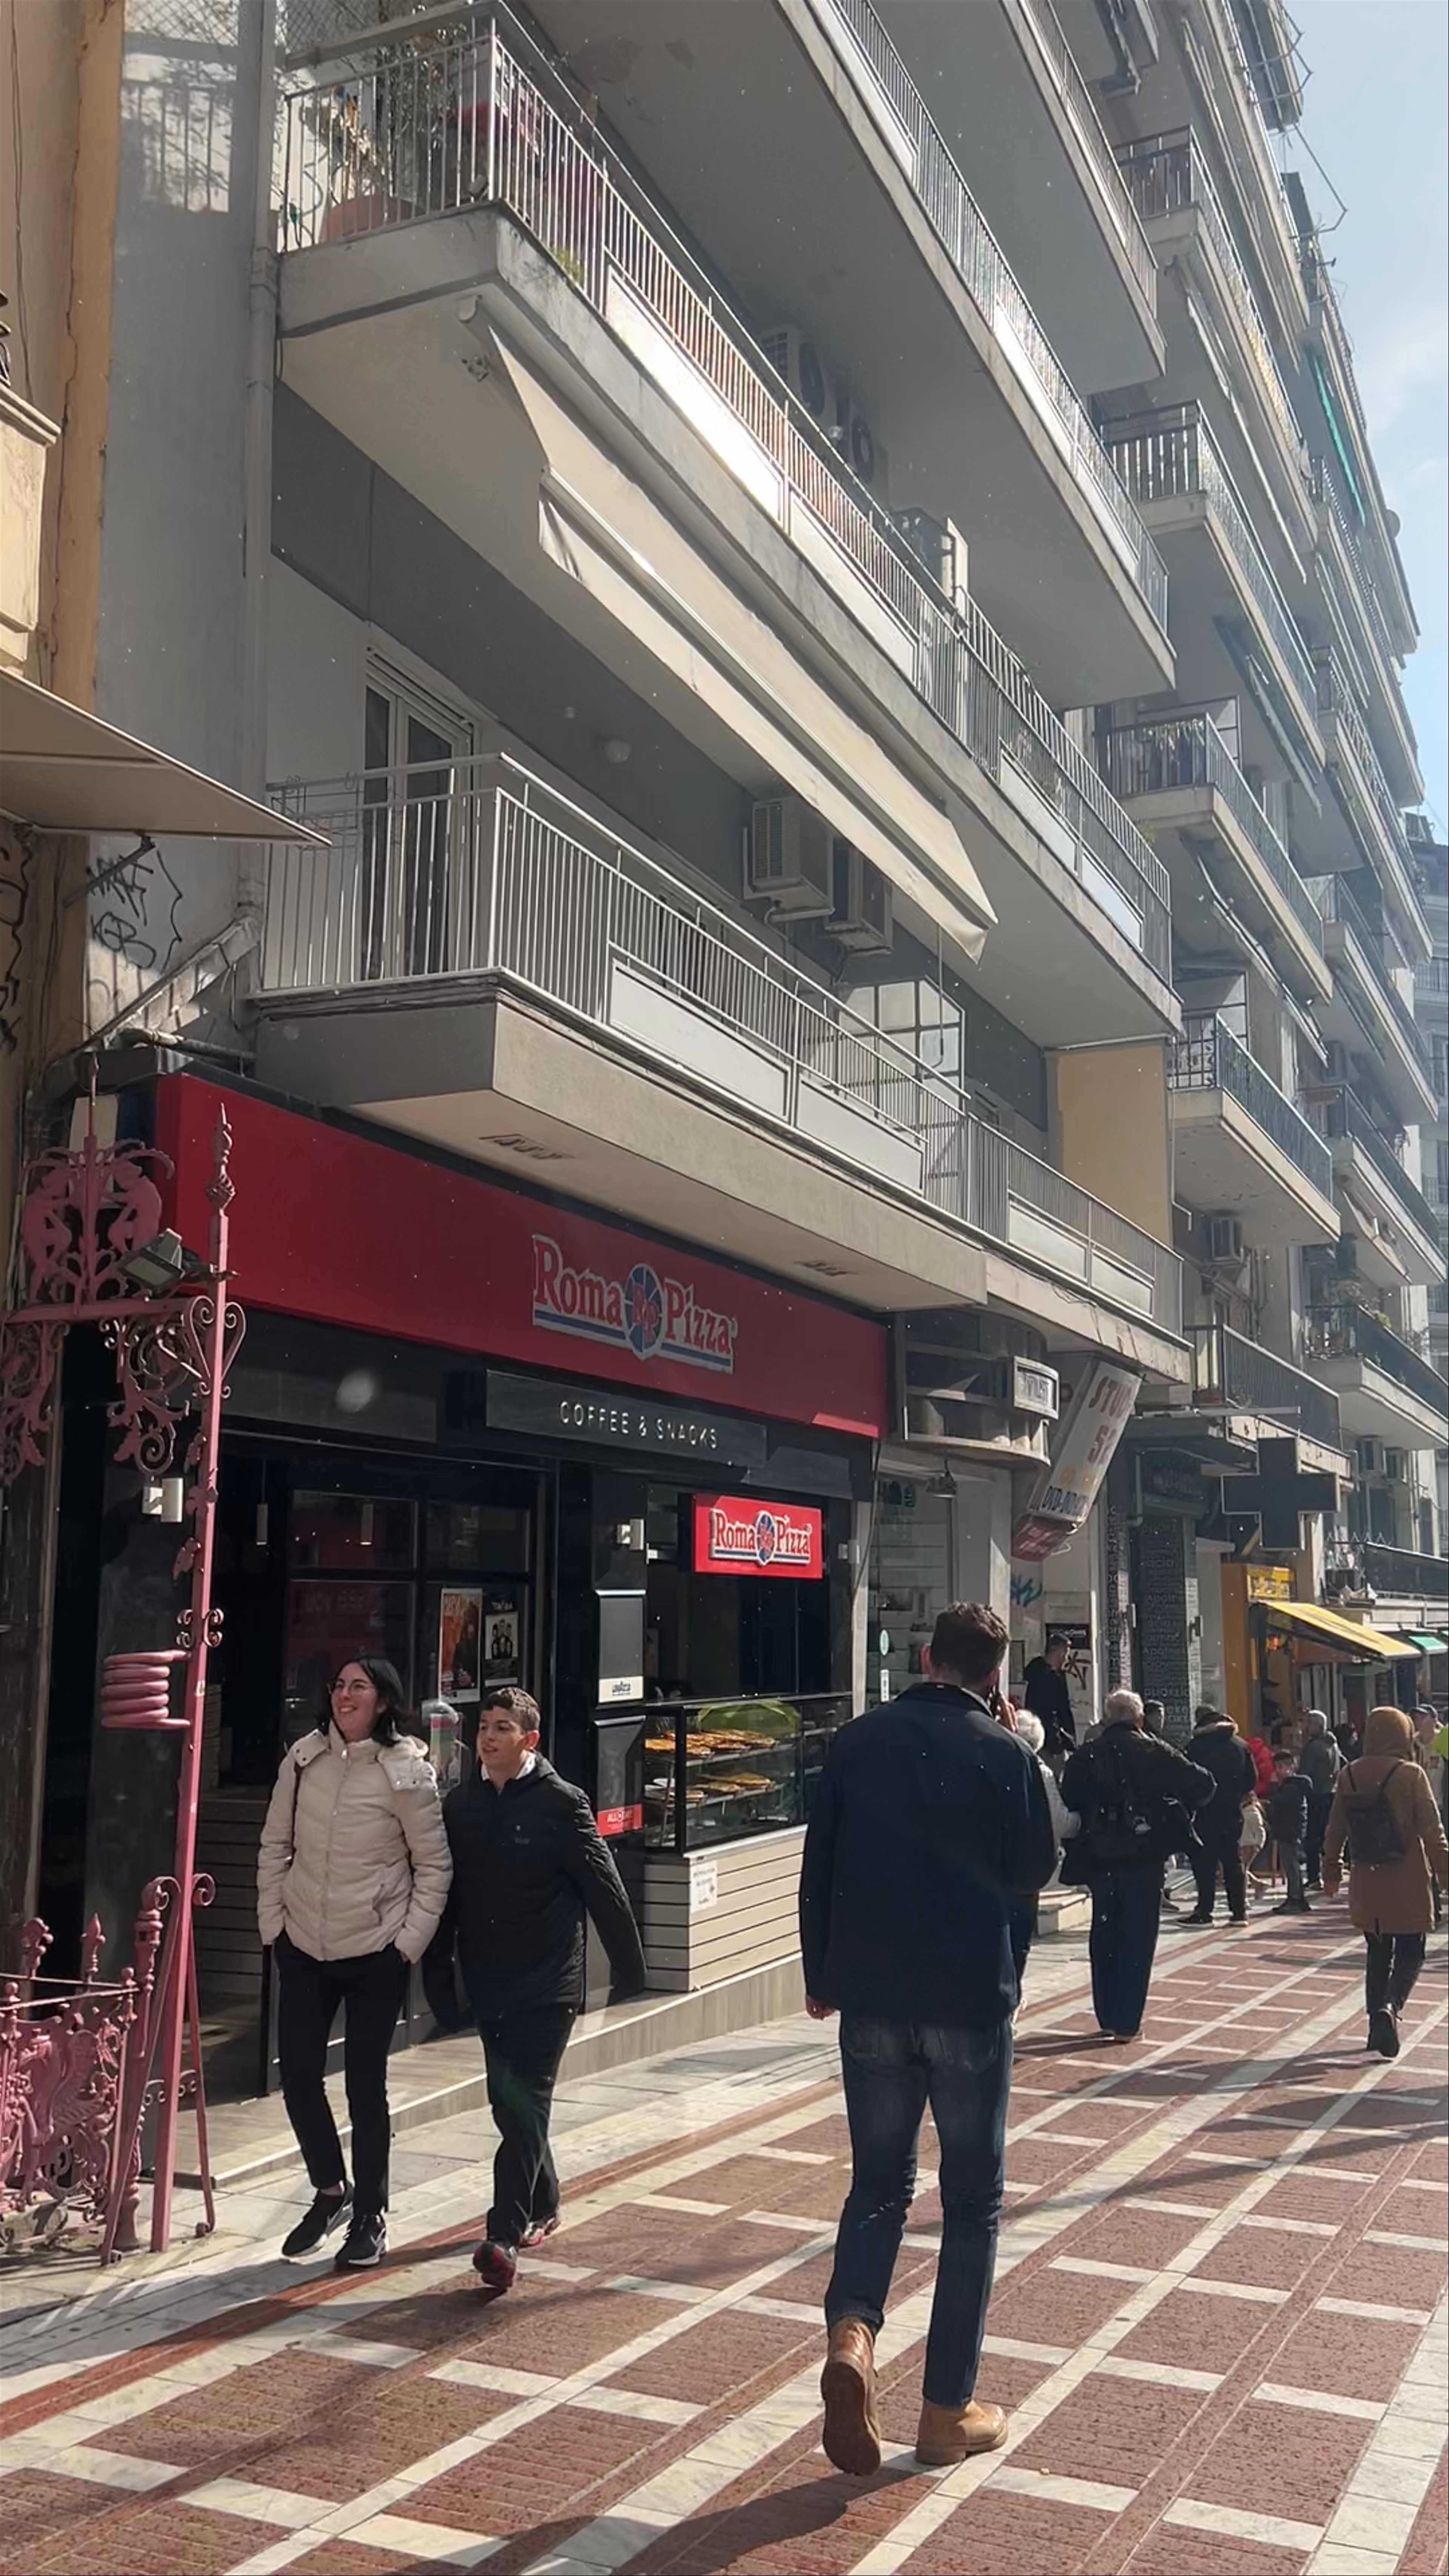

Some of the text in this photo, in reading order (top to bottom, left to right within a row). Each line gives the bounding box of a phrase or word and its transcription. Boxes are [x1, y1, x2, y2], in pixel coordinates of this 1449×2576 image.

[534, 1238, 731, 1354] Roma Pizza
[560, 1401, 717, 1449] COFFEE & SNACKS
[715, 1510, 809, 1554] Roma Pizza
